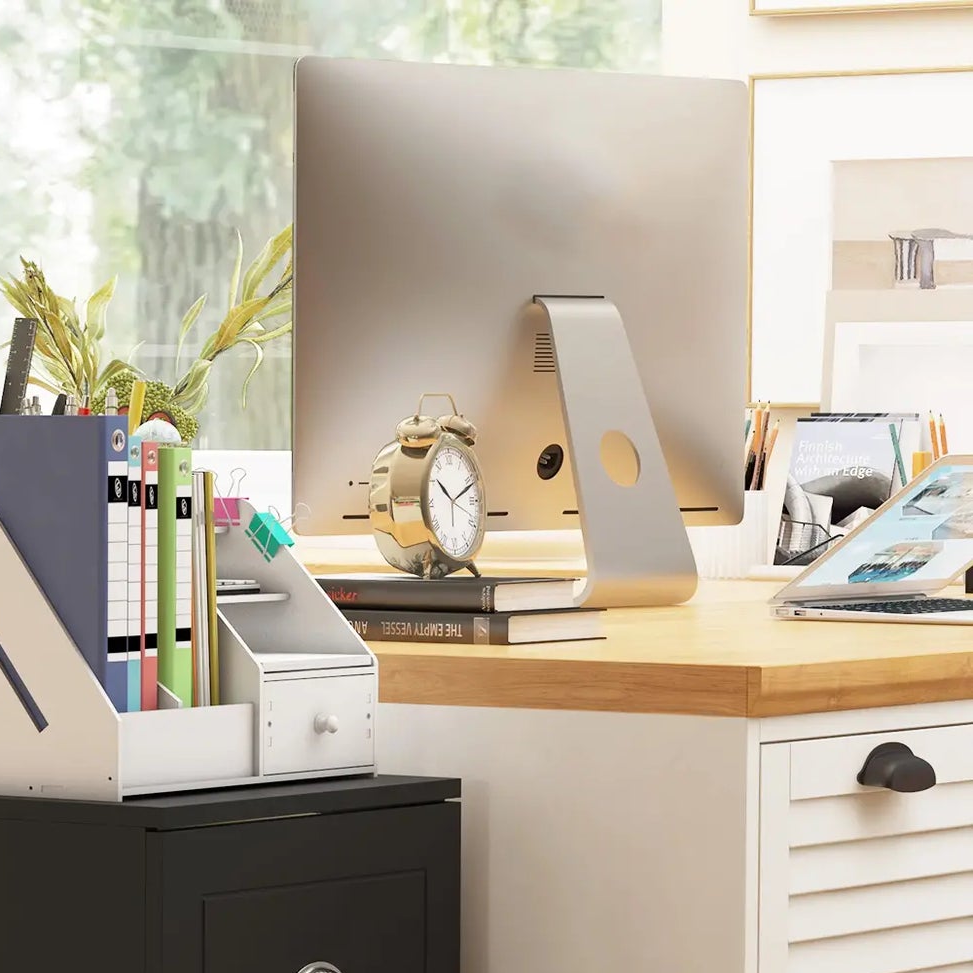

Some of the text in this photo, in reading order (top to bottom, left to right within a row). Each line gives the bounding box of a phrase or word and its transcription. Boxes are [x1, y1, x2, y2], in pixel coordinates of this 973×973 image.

[798, 440, 843, 452] Finnish
[842, 465, 873, 479] Edge
[327, 586, 359, 602] icker
[380, 621, 413, 636] VESSEL
[414, 622, 444, 637] EMPTY
[445, 623, 463, 637] THE
